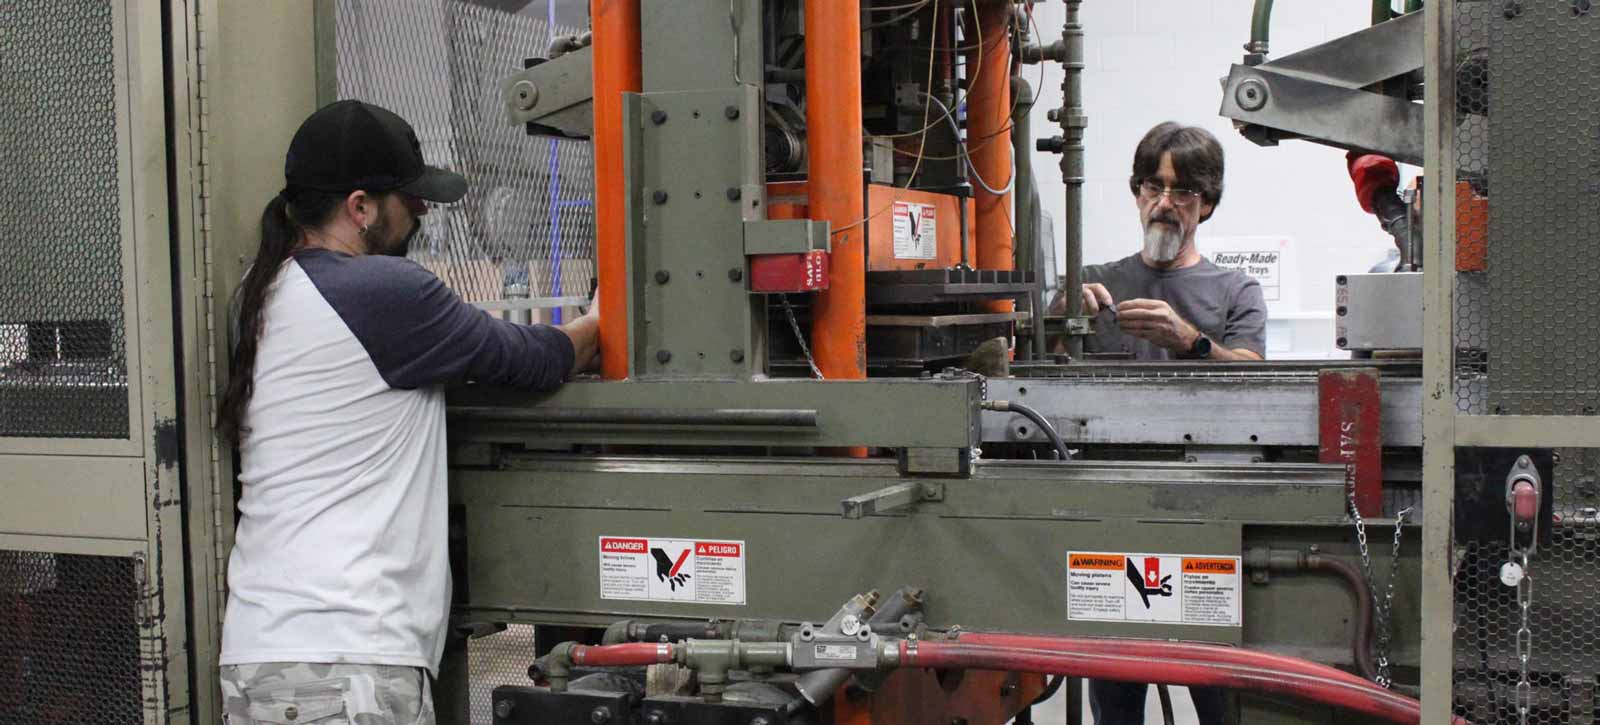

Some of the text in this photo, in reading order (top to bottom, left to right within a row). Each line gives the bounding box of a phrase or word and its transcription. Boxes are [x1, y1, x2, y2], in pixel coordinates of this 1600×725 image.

[1215, 253, 1277, 265] Ready-Made
[1248, 265, 1269, 275] Trays
[612, 541, 645, 551] DANGER
[708, 545, 737, 554] PELIGRO
[1081, 558, 1123, 568] WARNING
[1195, 562, 1234, 570] ADVERTENCIA
